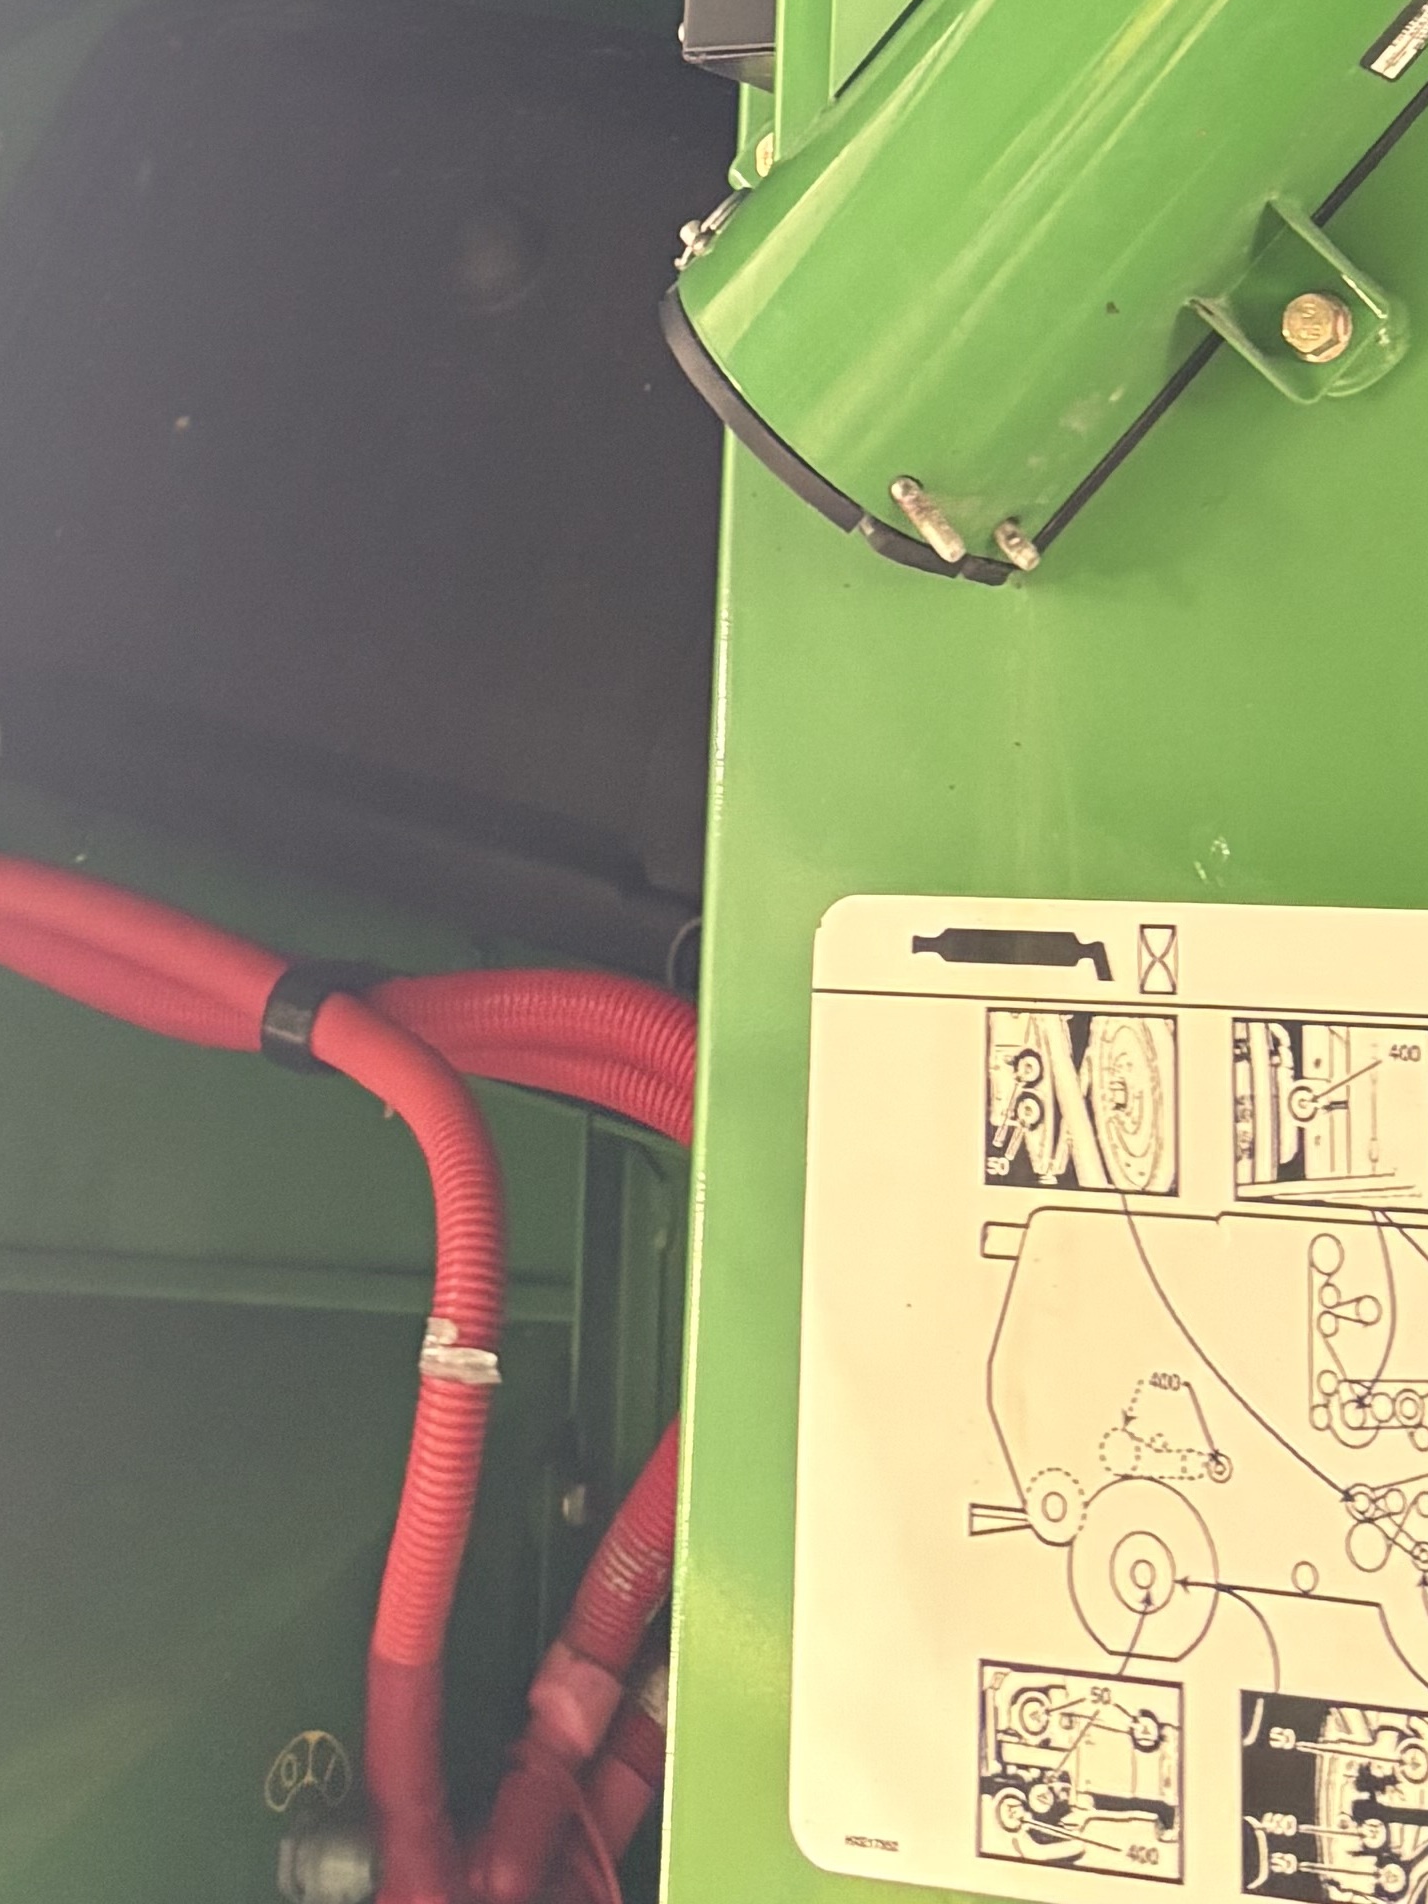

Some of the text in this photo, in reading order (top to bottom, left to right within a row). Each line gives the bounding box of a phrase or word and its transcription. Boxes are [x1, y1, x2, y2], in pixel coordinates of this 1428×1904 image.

[1388, 1043, 1422, 1062] 400
[985, 1156, 1010, 1176] 50
[1148, 1371, 1181, 1391] 400
[1090, 1686, 1112, 1705] 50
[1269, 1727, 1296, 1750] 50
[1126, 1844, 1160, 1866] 400
[1270, 1851, 1298, 1875] 50
